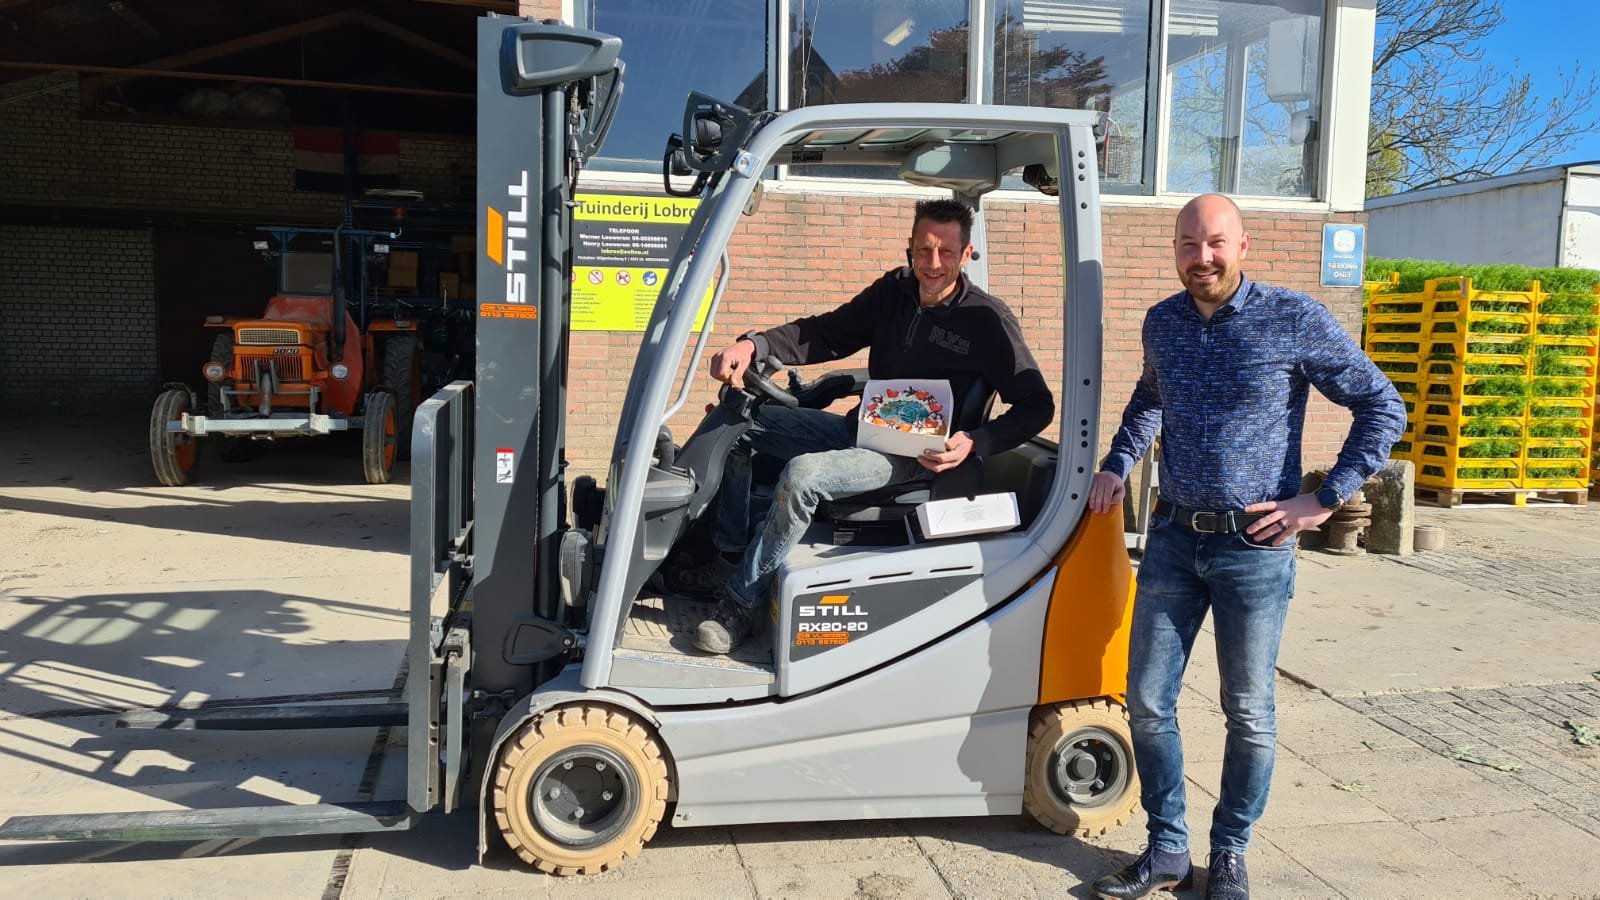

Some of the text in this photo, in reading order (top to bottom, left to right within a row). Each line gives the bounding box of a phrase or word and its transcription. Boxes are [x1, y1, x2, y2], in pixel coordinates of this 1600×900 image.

[578, 200, 649, 219] Tuinderij
[506, 170, 528, 303] STILL
[799, 605, 869, 617] STILL
